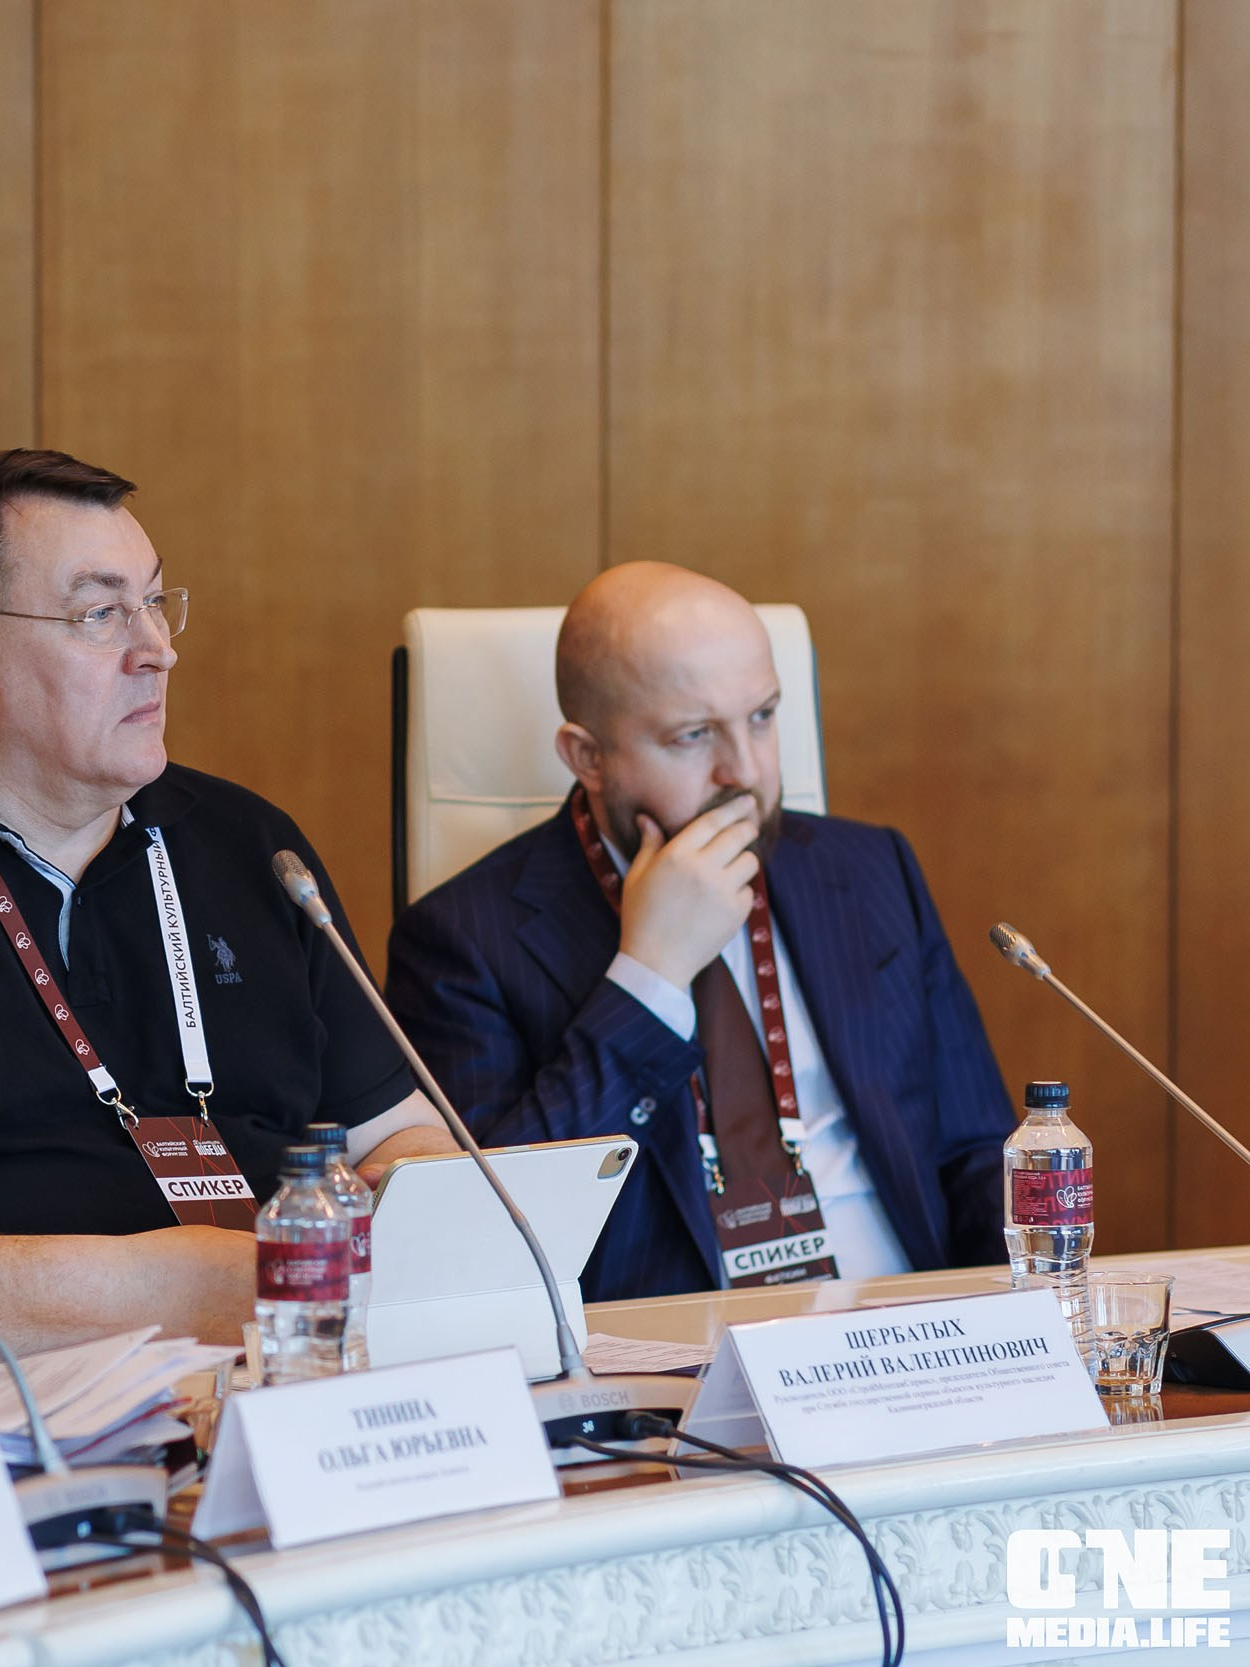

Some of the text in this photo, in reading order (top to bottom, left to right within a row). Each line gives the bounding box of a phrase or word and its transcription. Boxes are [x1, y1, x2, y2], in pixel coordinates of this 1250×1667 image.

[167, 931, 196, 1028] БАЛТИЙСКИЙ
[215, 971, 243, 985] USPA
[168, 1180, 244, 1197] СПИКЕР
[734, 1237, 825, 1270] СПИКЕР
[844, 1318, 967, 1351] ЩЕРБАТЫХ
[778, 1337, 1051, 1387] ВАЛЕРИЙ ВАЛЕНТИНОВИЧ
[350, 1399, 437, 1431] ТИНИНА
[581, 1390, 630, 1408] BOSCH
[317, 1426, 488, 1473] ОЛЬГА ЮРЬЕВНА
